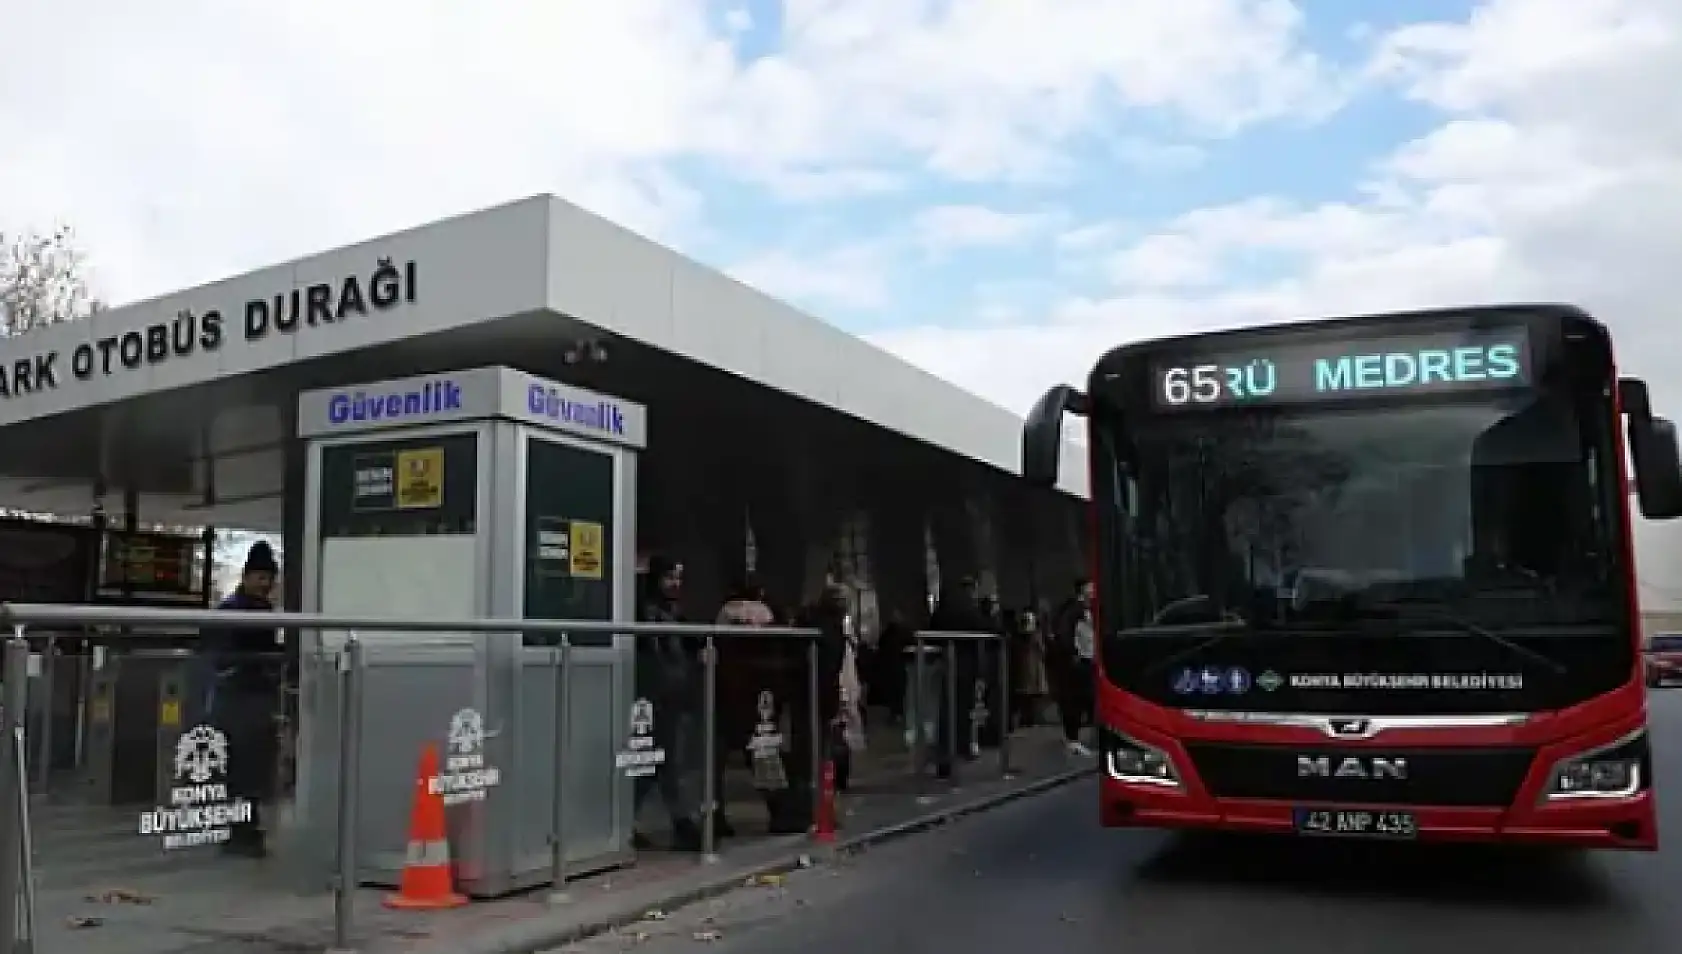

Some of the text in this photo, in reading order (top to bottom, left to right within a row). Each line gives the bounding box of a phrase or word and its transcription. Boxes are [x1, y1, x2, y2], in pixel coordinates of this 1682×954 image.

[72, 309, 222, 379] OTOBÜS
[245, 256, 417, 340] DURAĞI
[1165, 365, 1220, 404] 65
[1315, 345, 1521, 392] MEDRES
[328, 380, 463, 424] Güvenlik
[528, 383, 624, 435] Güvenlik
[1297, 755, 1408, 779] MAN
